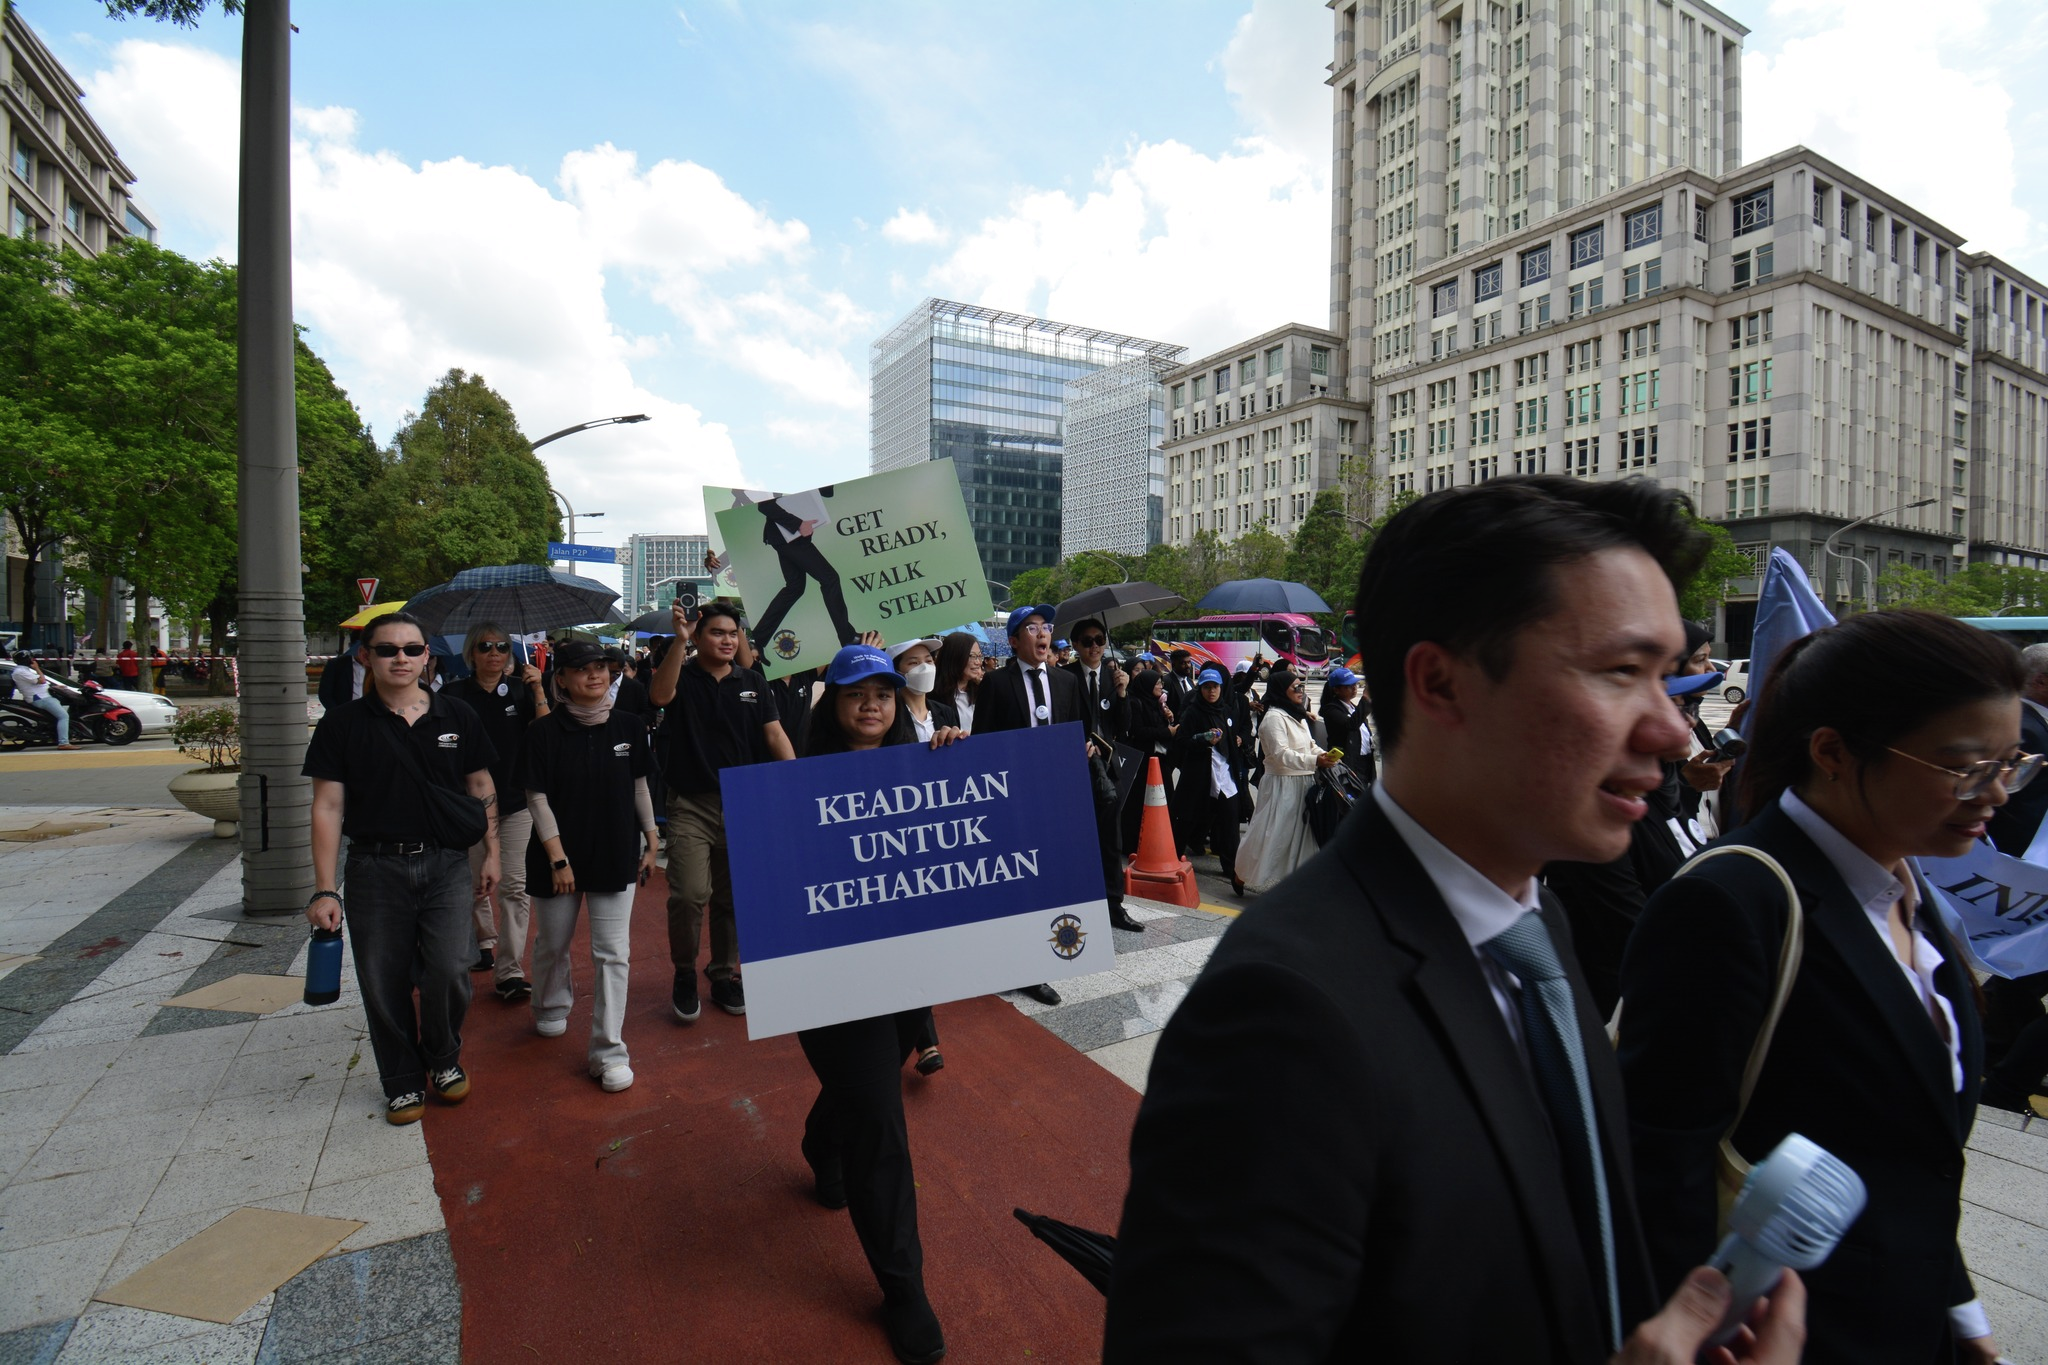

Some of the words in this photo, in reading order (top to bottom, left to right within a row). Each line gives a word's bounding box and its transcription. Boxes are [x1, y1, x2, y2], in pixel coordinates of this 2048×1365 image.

[836, 508, 884, 537] GET
[859, 520, 948, 557] READY,
[551, 547, 570, 556] Jalan
[572, 548, 588, 557] P2P
[850, 560, 926, 595] WALK
[878, 579, 968, 620] STEADY
[815, 771, 1010, 826] KEADILAN
[849, 815, 991, 863] UNTUK
[804, 849, 1040, 915] KEHAKIMAN
